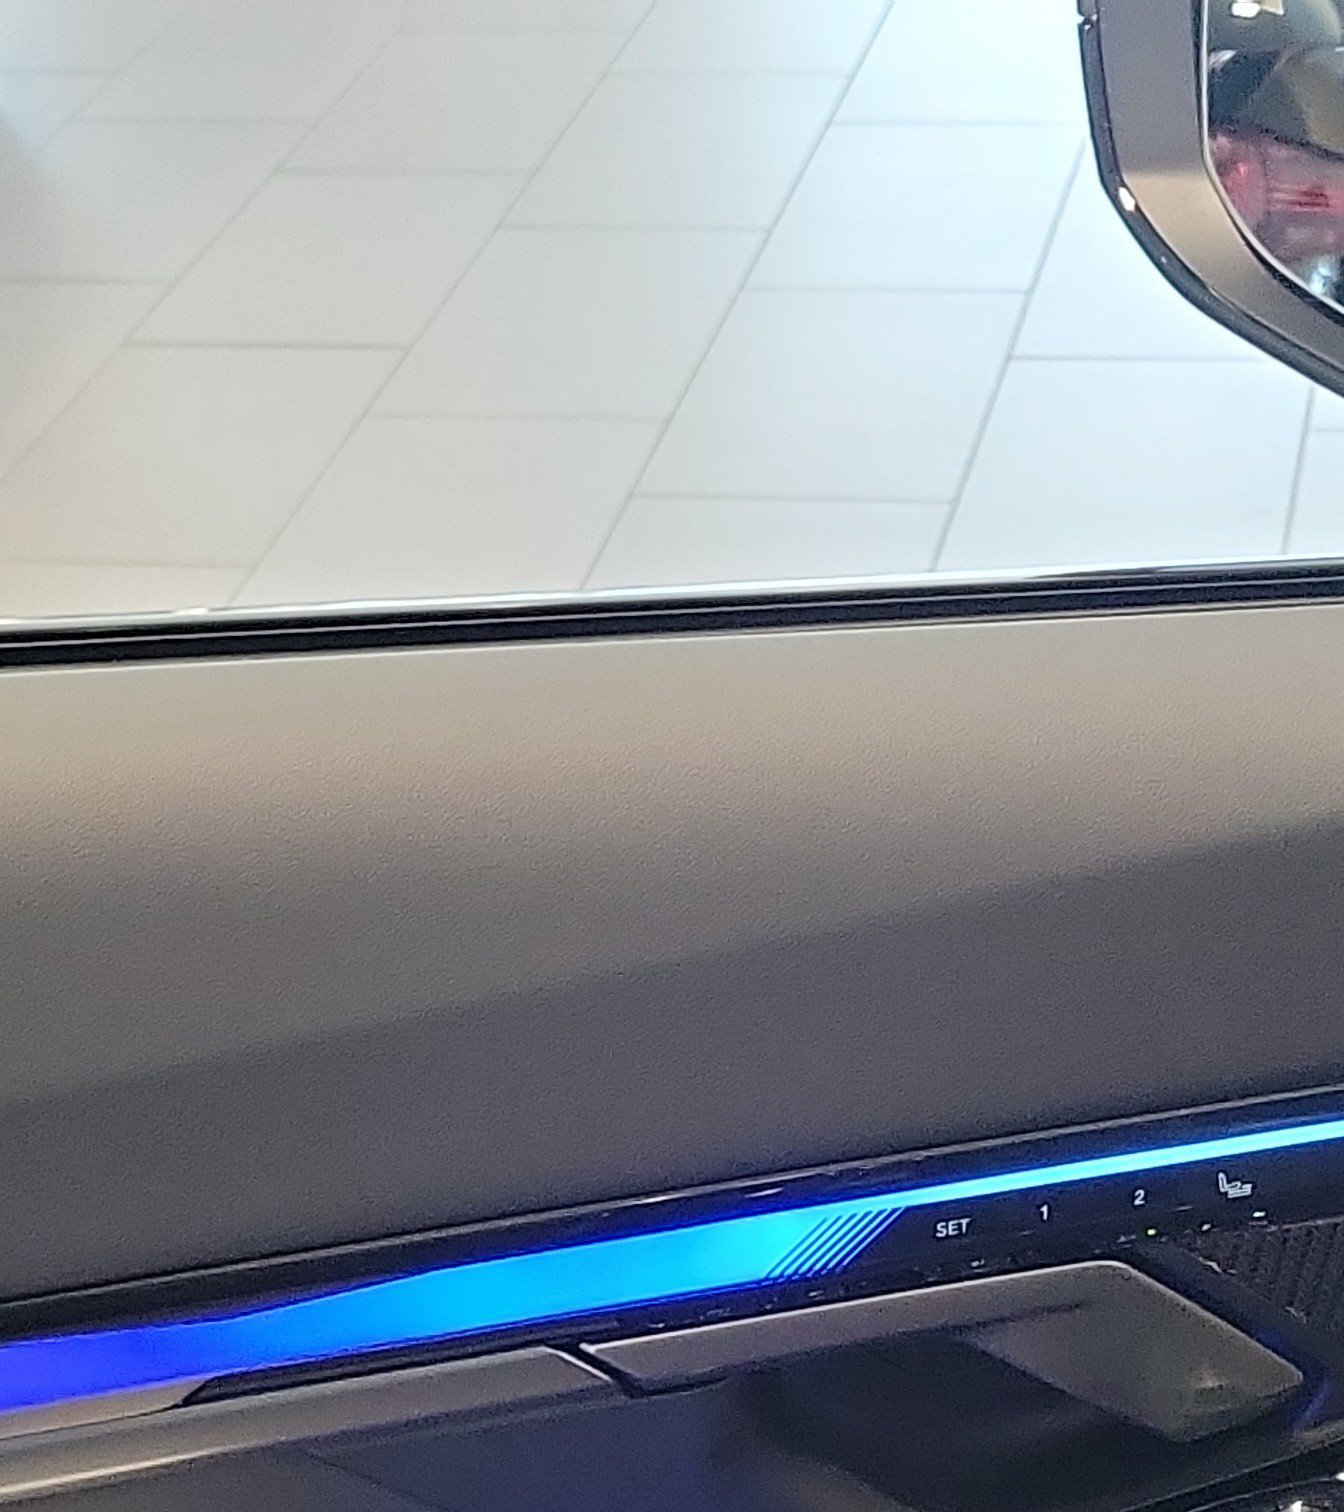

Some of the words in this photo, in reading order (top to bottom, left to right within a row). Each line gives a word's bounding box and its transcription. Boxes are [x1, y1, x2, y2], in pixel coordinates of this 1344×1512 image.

[935, 1217, 972, 1238] SET
[1039, 1203, 1049, 1221] 1
[1133, 1189, 1146, 1206] 2
